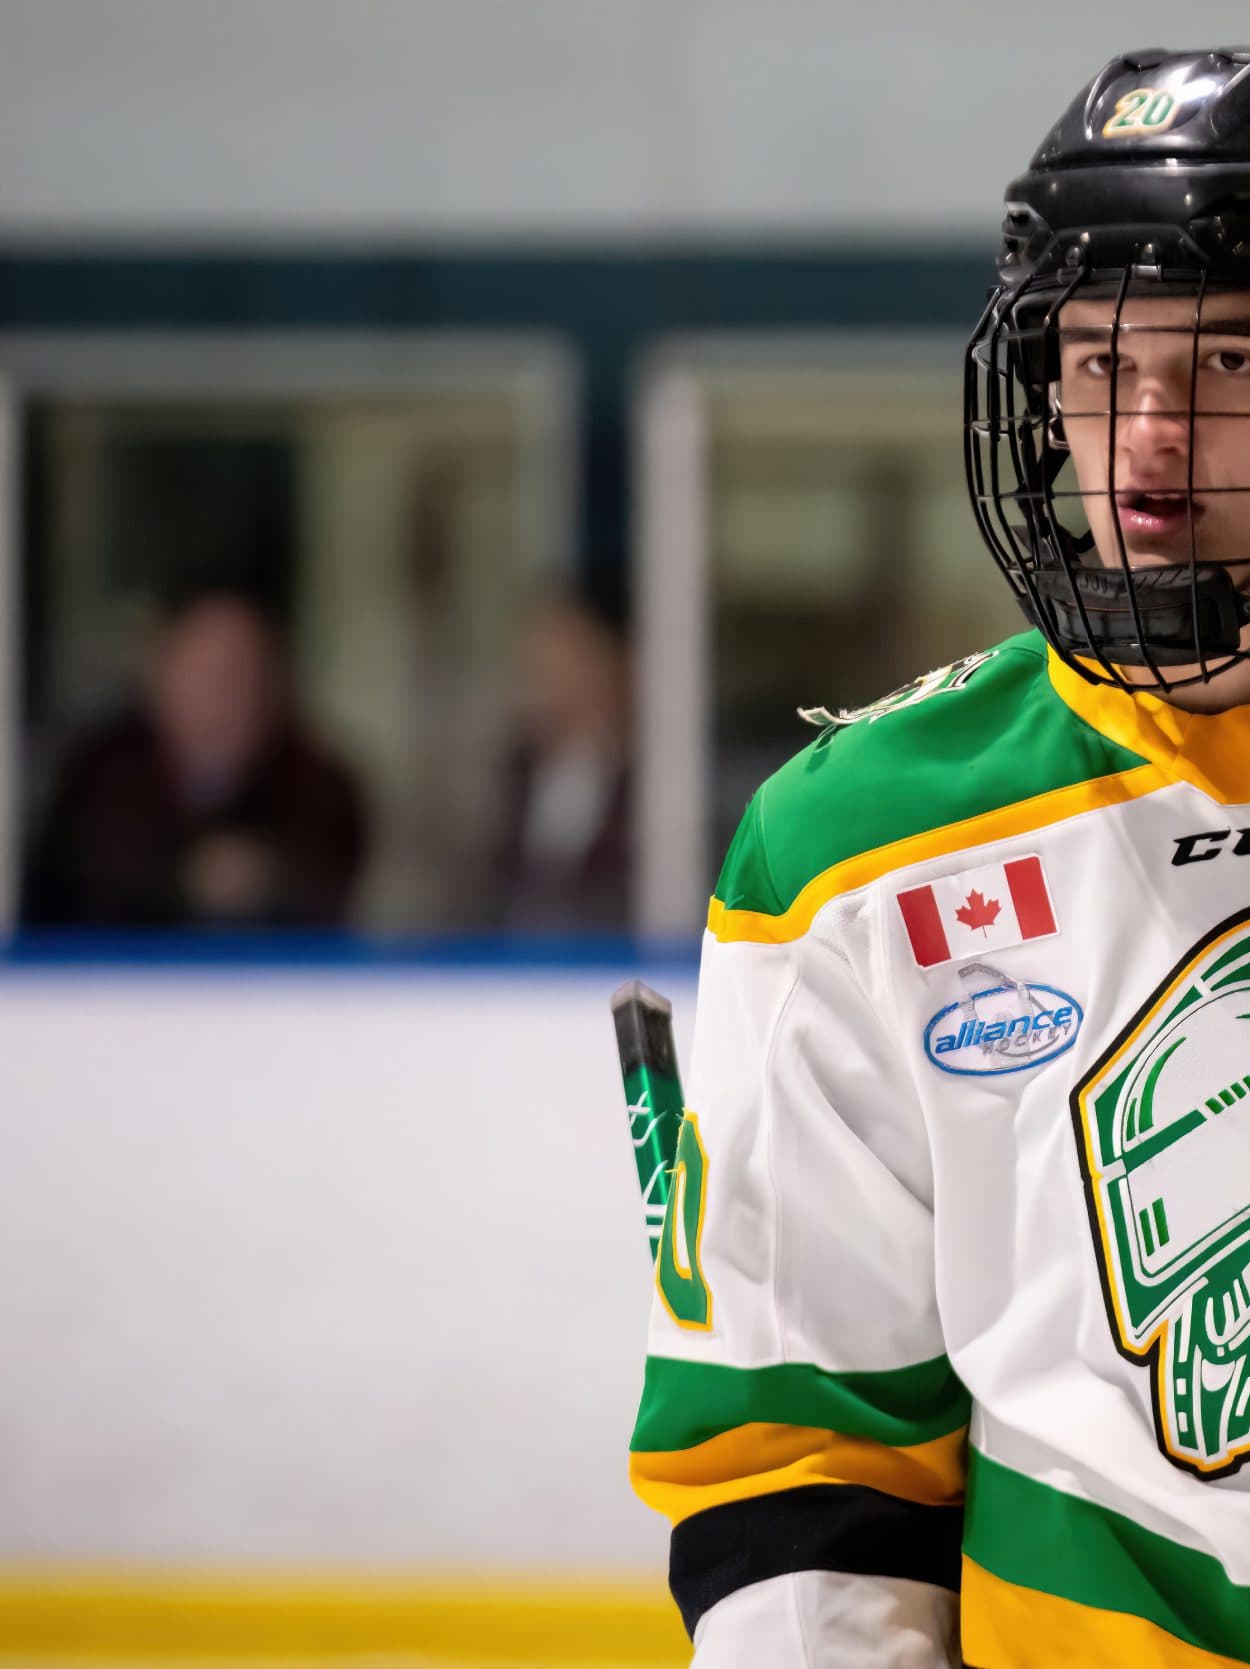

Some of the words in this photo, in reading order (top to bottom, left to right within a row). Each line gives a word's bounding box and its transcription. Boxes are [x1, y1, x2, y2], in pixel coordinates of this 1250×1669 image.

[1107, 89, 1176, 135] 20
[935, 1006, 1072, 1053] alliance
[982, 1024, 1070, 1056] HOCKEY
